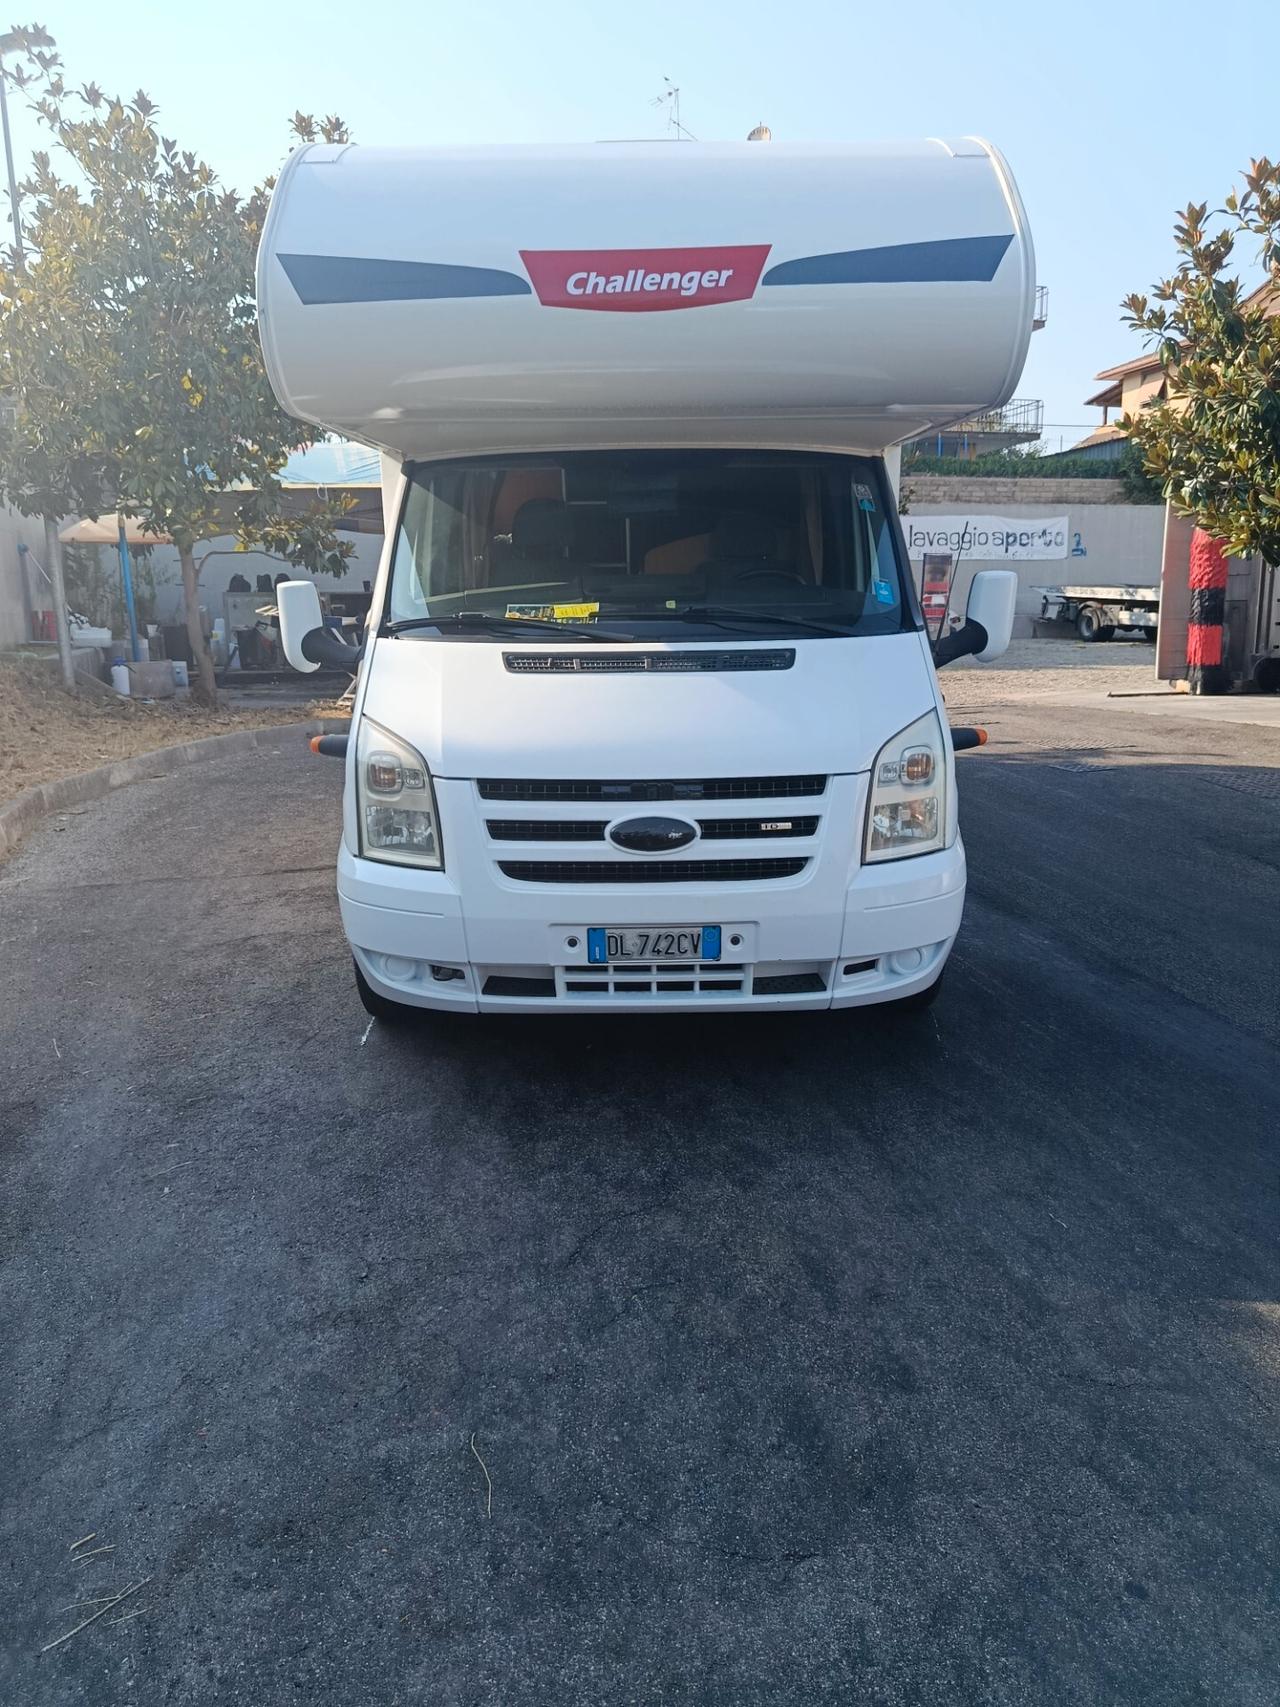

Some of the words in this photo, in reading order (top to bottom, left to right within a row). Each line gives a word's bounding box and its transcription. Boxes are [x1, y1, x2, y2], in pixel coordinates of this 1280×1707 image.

[566, 268, 733, 296] Challenger
[908, 524, 989, 551] lavaggio
[992, 528, 1065, 553] aperto
[607, 934, 631, 957] DL
[639, 933, 701, 956] 742CV
